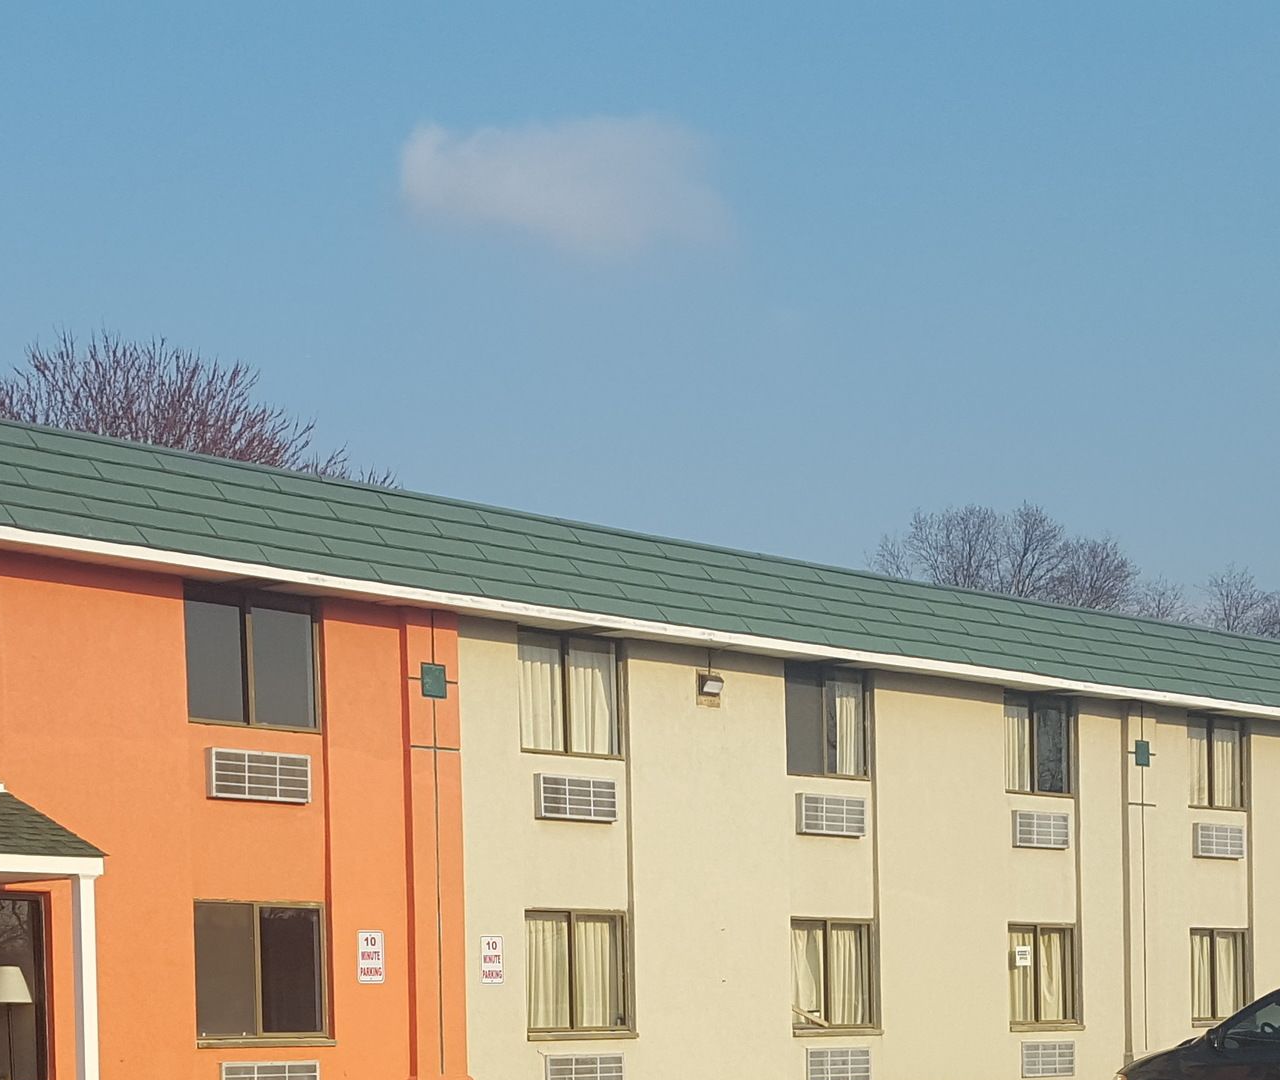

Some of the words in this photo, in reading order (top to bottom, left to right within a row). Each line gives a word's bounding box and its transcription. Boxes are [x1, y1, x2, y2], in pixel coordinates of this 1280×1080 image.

[363, 936, 377, 947] 10
[485, 940, 498, 951] 10
[361, 951, 381, 961] MINUTE
[483, 954, 501, 964] MINUTE
[360, 967, 382, 977] PARKING
[482, 969, 503, 979] PARKING
